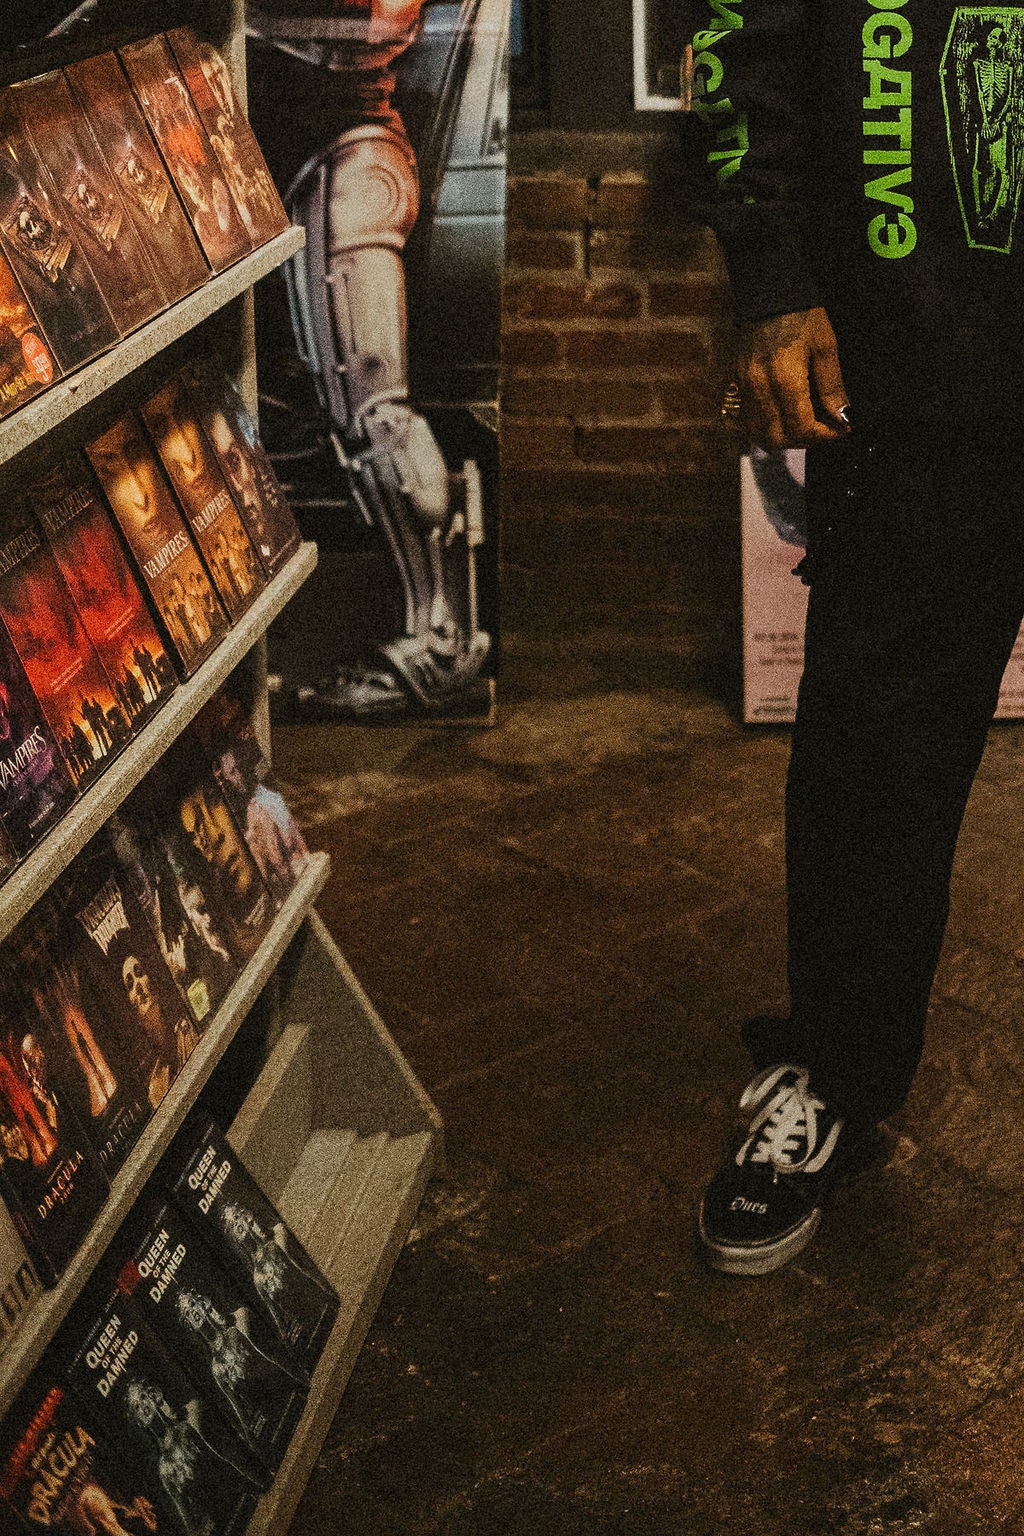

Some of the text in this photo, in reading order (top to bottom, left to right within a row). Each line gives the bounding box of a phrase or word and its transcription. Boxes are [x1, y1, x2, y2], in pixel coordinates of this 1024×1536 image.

[192, 489, 231, 533] VAMPIRES
[143, 530, 190, 579] VAMPIRES
[0, 725, 47, 790] VAMPIRES
[37, 1150, 85, 1220] DRACULA
[188, 1145, 217, 1191] QUEEN
[198, 1160, 232, 1215] DAMNED
[138, 1228, 170, 1279] QUEEN
[149, 1244, 187, 1304] DAMNED
[152, 1249, 171, 1279] OF THE
[86, 1313, 122, 1370] QUEEN
[97, 1330, 139, 1398] DAMNED
[101, 1335, 123, 1370] OF THE
